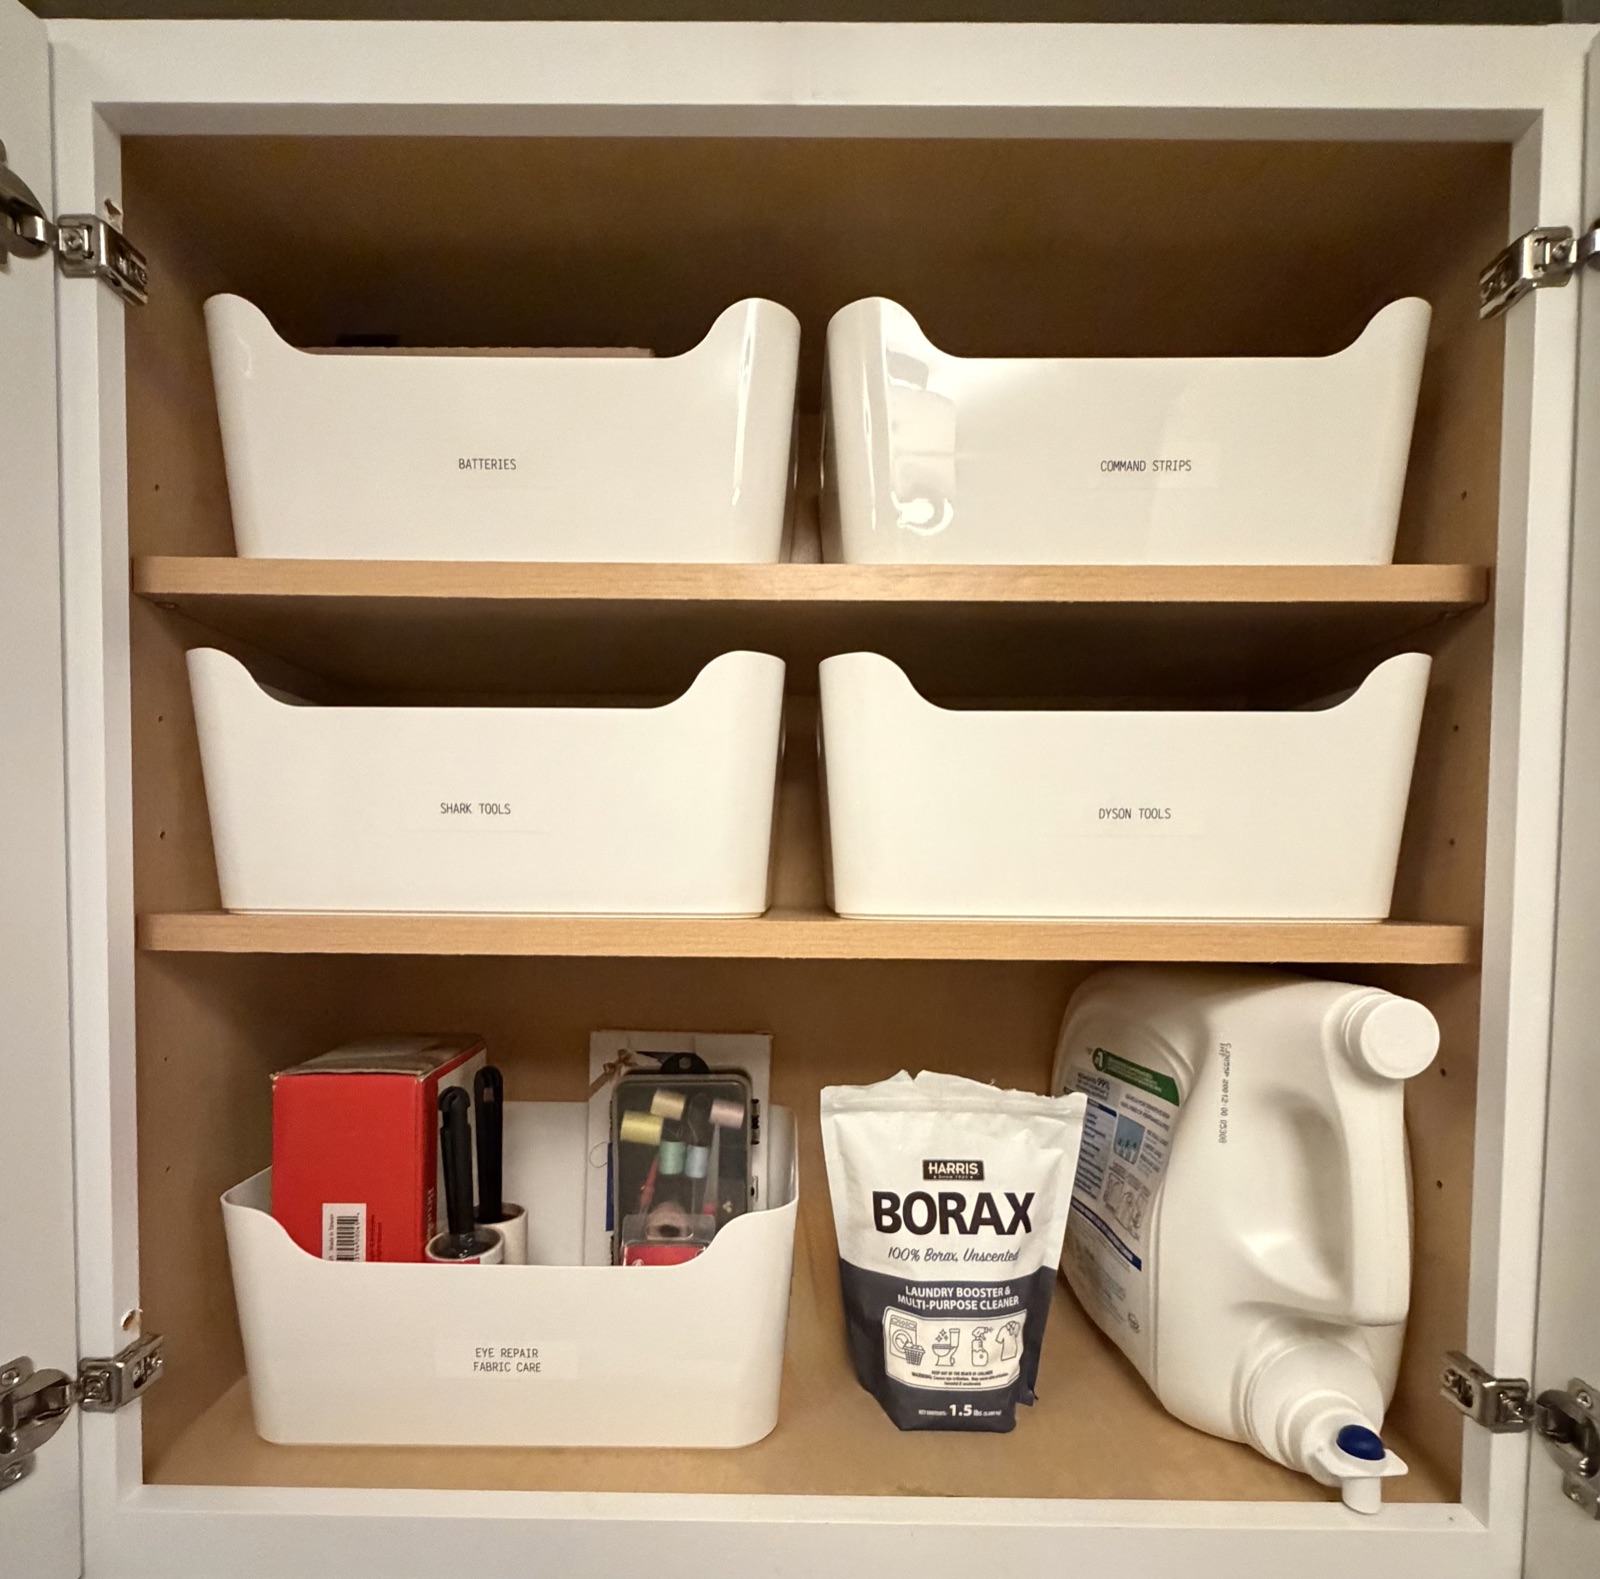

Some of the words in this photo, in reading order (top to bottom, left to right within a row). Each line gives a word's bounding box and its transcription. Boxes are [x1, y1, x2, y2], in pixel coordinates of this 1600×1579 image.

[458, 458, 517, 470] BATTERIES
[1100, 460, 1146, 472] COMMAND
[1152, 460, 1192, 472] STRIPS
[440, 802, 472, 814] SHARK
[478, 803, 511, 815] TOOLS
[1098, 807, 1132, 819] DYSON
[1138, 808, 1172, 819] TOOLS
[928, 1162, 979, 1175] HARRIS
[872, 1190, 1036, 1235] BORAX
[888, 1247, 920, 1261] 100%
[924, 1248, 958, 1262] Borax,
[963, 1247, 1020, 1262] Unscented
[905, 1285, 954, 1298] LAUNDRY
[956, 1287, 1004, 1298] BOOSTER
[1004, 1286, 1011, 1295] &
[898, 1294, 978, 1310] MULTI-PURPOSE
[980, 1295, 1019, 1310] CLEANER
[475, 1347, 494, 1358] EYE
[501, 1348, 539, 1358] REPAIR
[473, 1361, 511, 1372] FABRIC
[516, 1362, 541, 1372] CARE
[949, 1404, 972, 1416] 1.5
